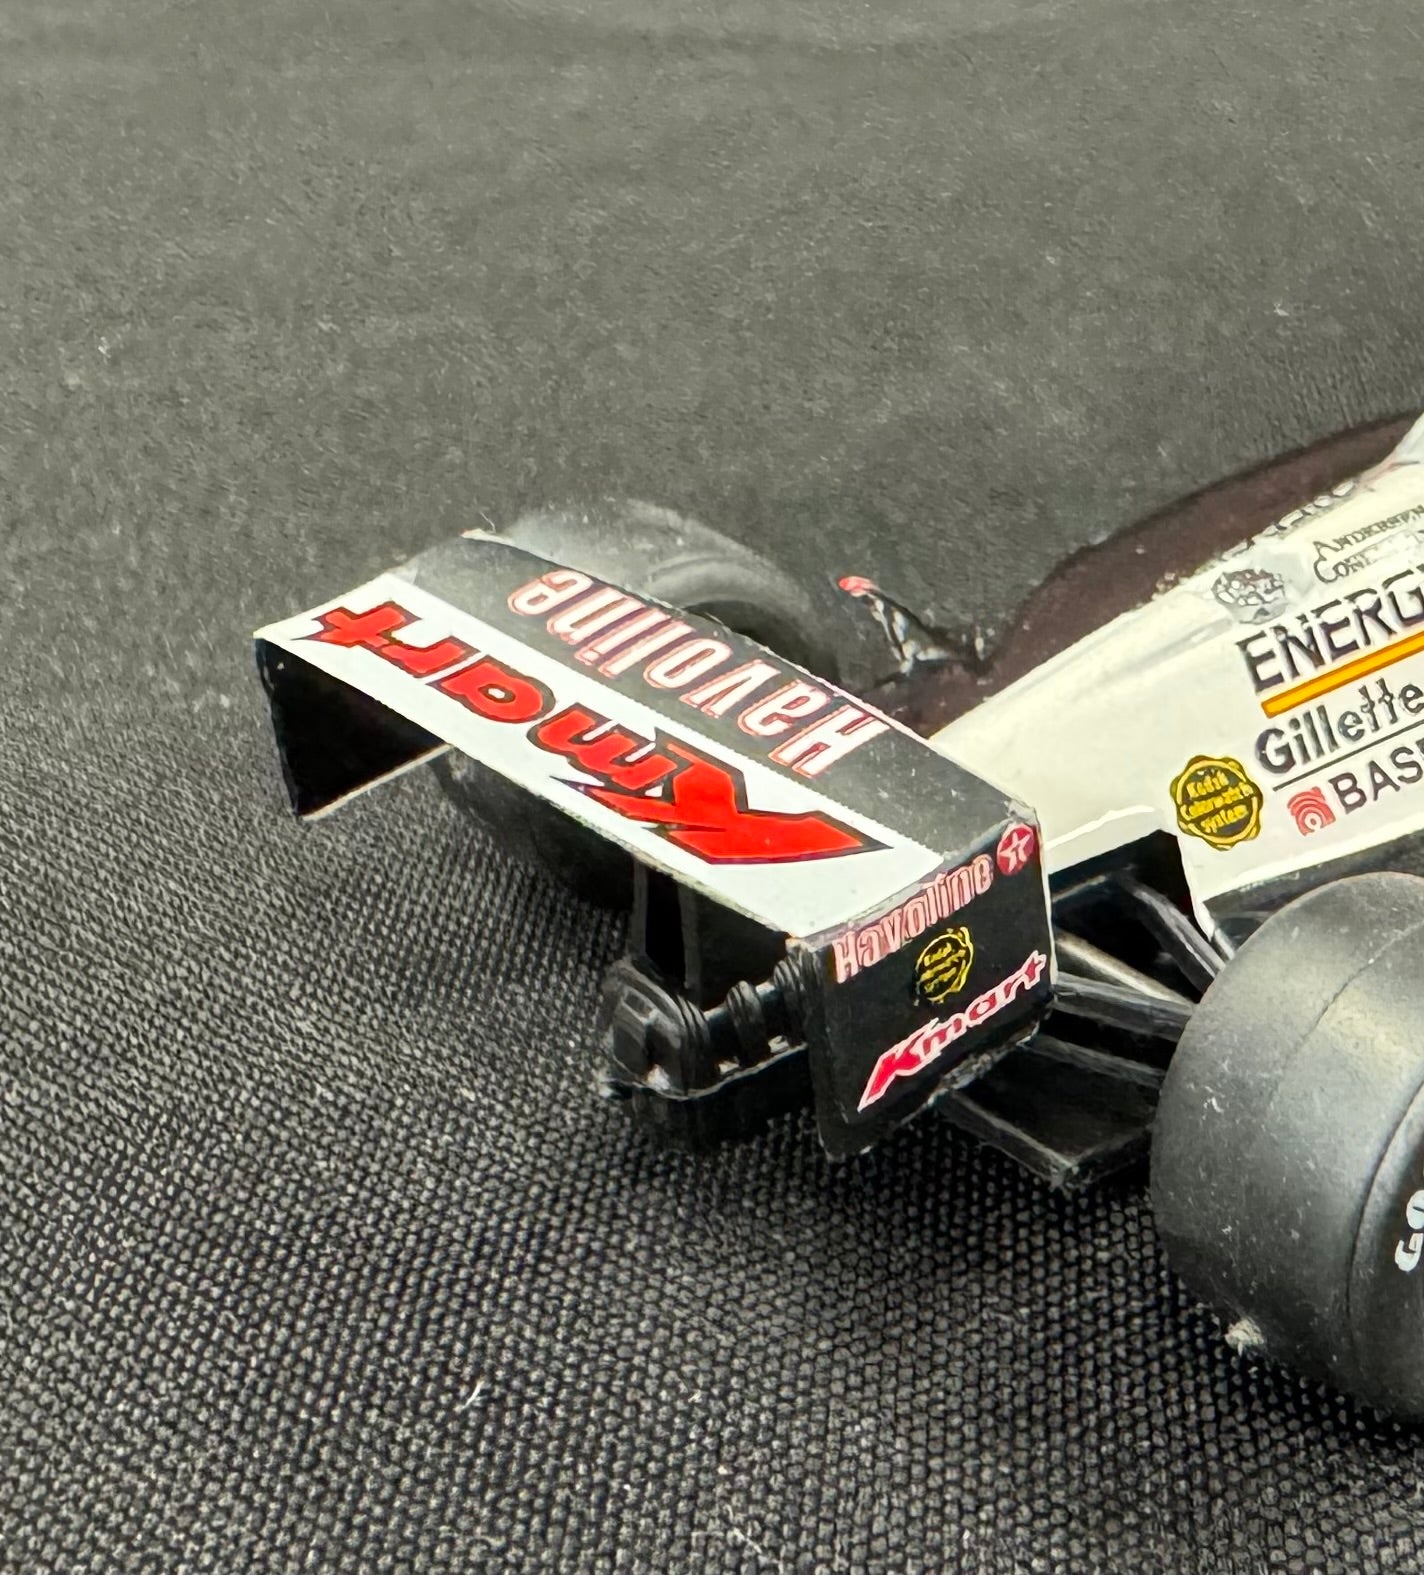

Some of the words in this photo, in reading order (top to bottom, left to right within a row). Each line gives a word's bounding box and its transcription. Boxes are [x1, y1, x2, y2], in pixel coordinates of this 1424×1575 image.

[290, 600, 895, 866] Kmart
[506, 568, 892, 780] Havoline
[832, 853, 995, 984] Havoline
[856, 950, 1048, 1113] Kmart
